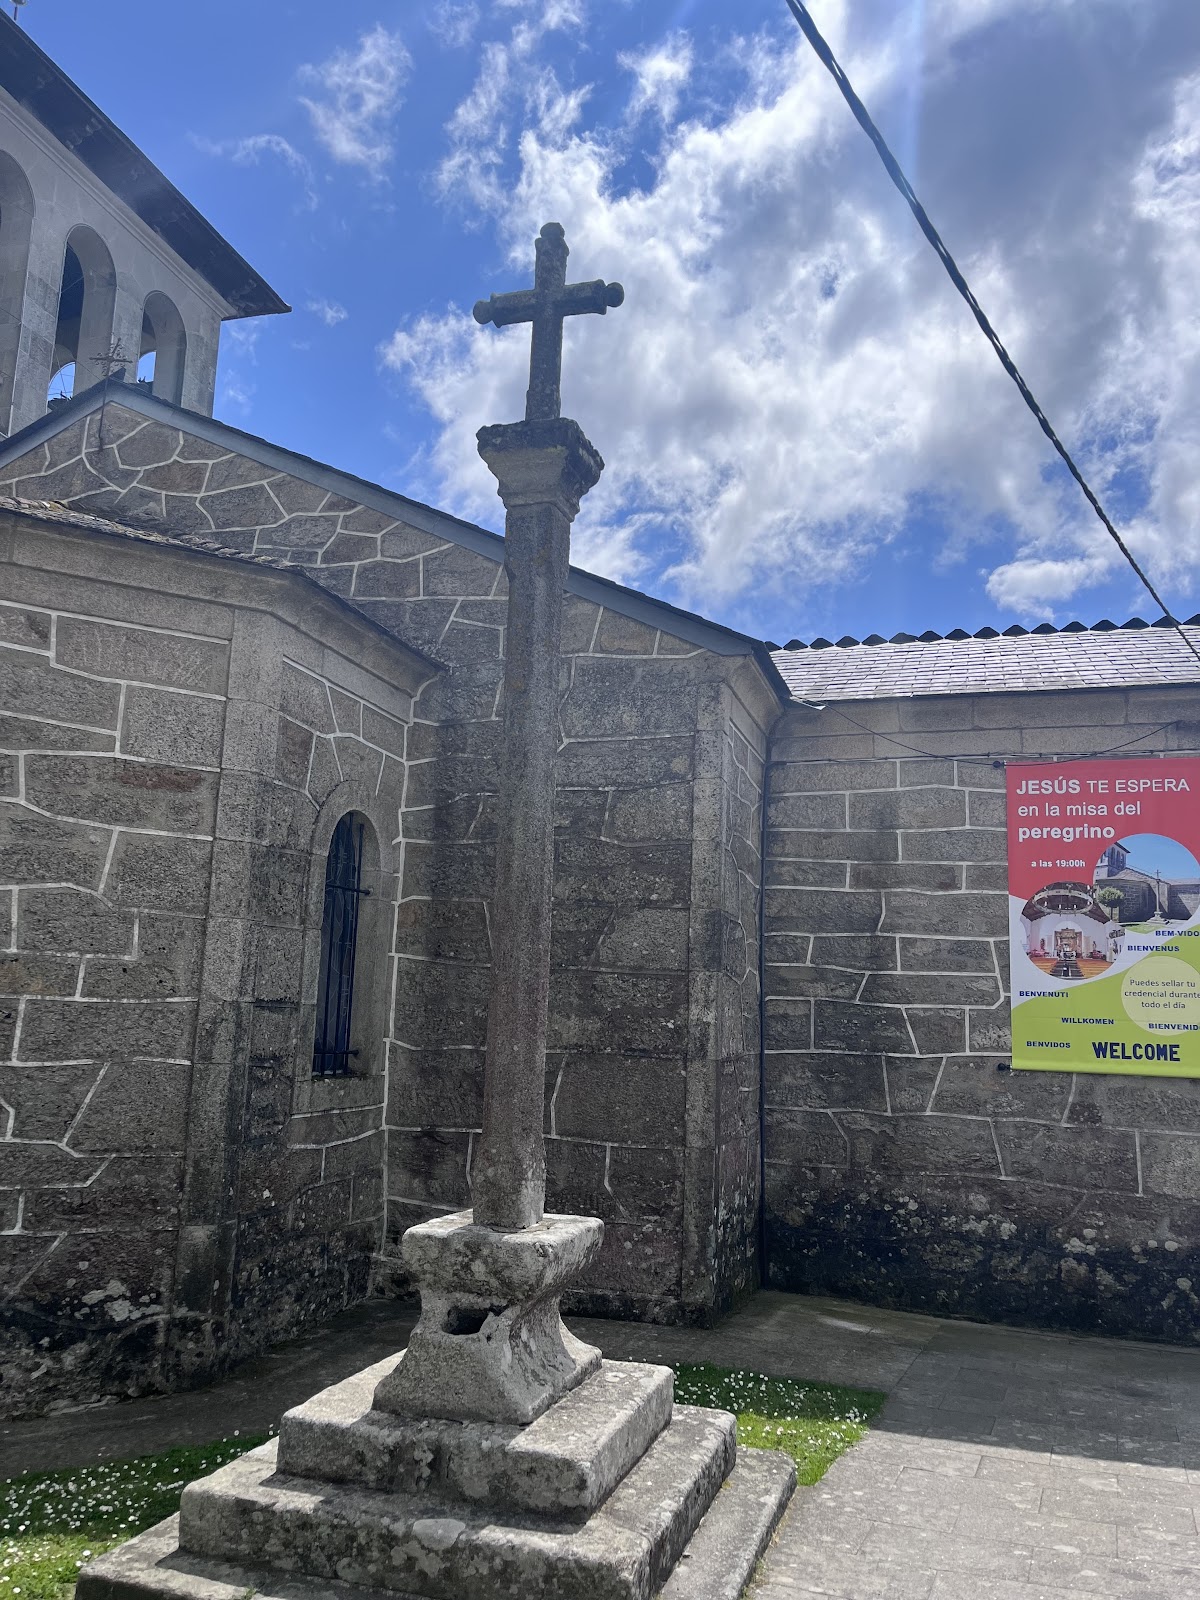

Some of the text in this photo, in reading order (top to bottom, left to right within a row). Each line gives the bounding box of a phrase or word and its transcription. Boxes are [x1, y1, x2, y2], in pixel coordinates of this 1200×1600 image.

[1016, 776, 1190, 795] JESÚS TE ESPERA
[1017, 801, 1141, 817] en la misa del
[1018, 824, 1115, 842] peregrino
[1039, 859, 1052, 867] las
[1129, 979, 1159, 987] Puedes
[1161, 980, 1184, 988] sellar
[1124, 990, 1167, 998] credencial
[1061, 1017, 1115, 1025] WILLKOMEN
[1148, 1023, 1200, 1031] BIENVENID
[1026, 1041, 1071, 1049] BENVIDOS
[1092, 1041, 1181, 1062] WELCOME
